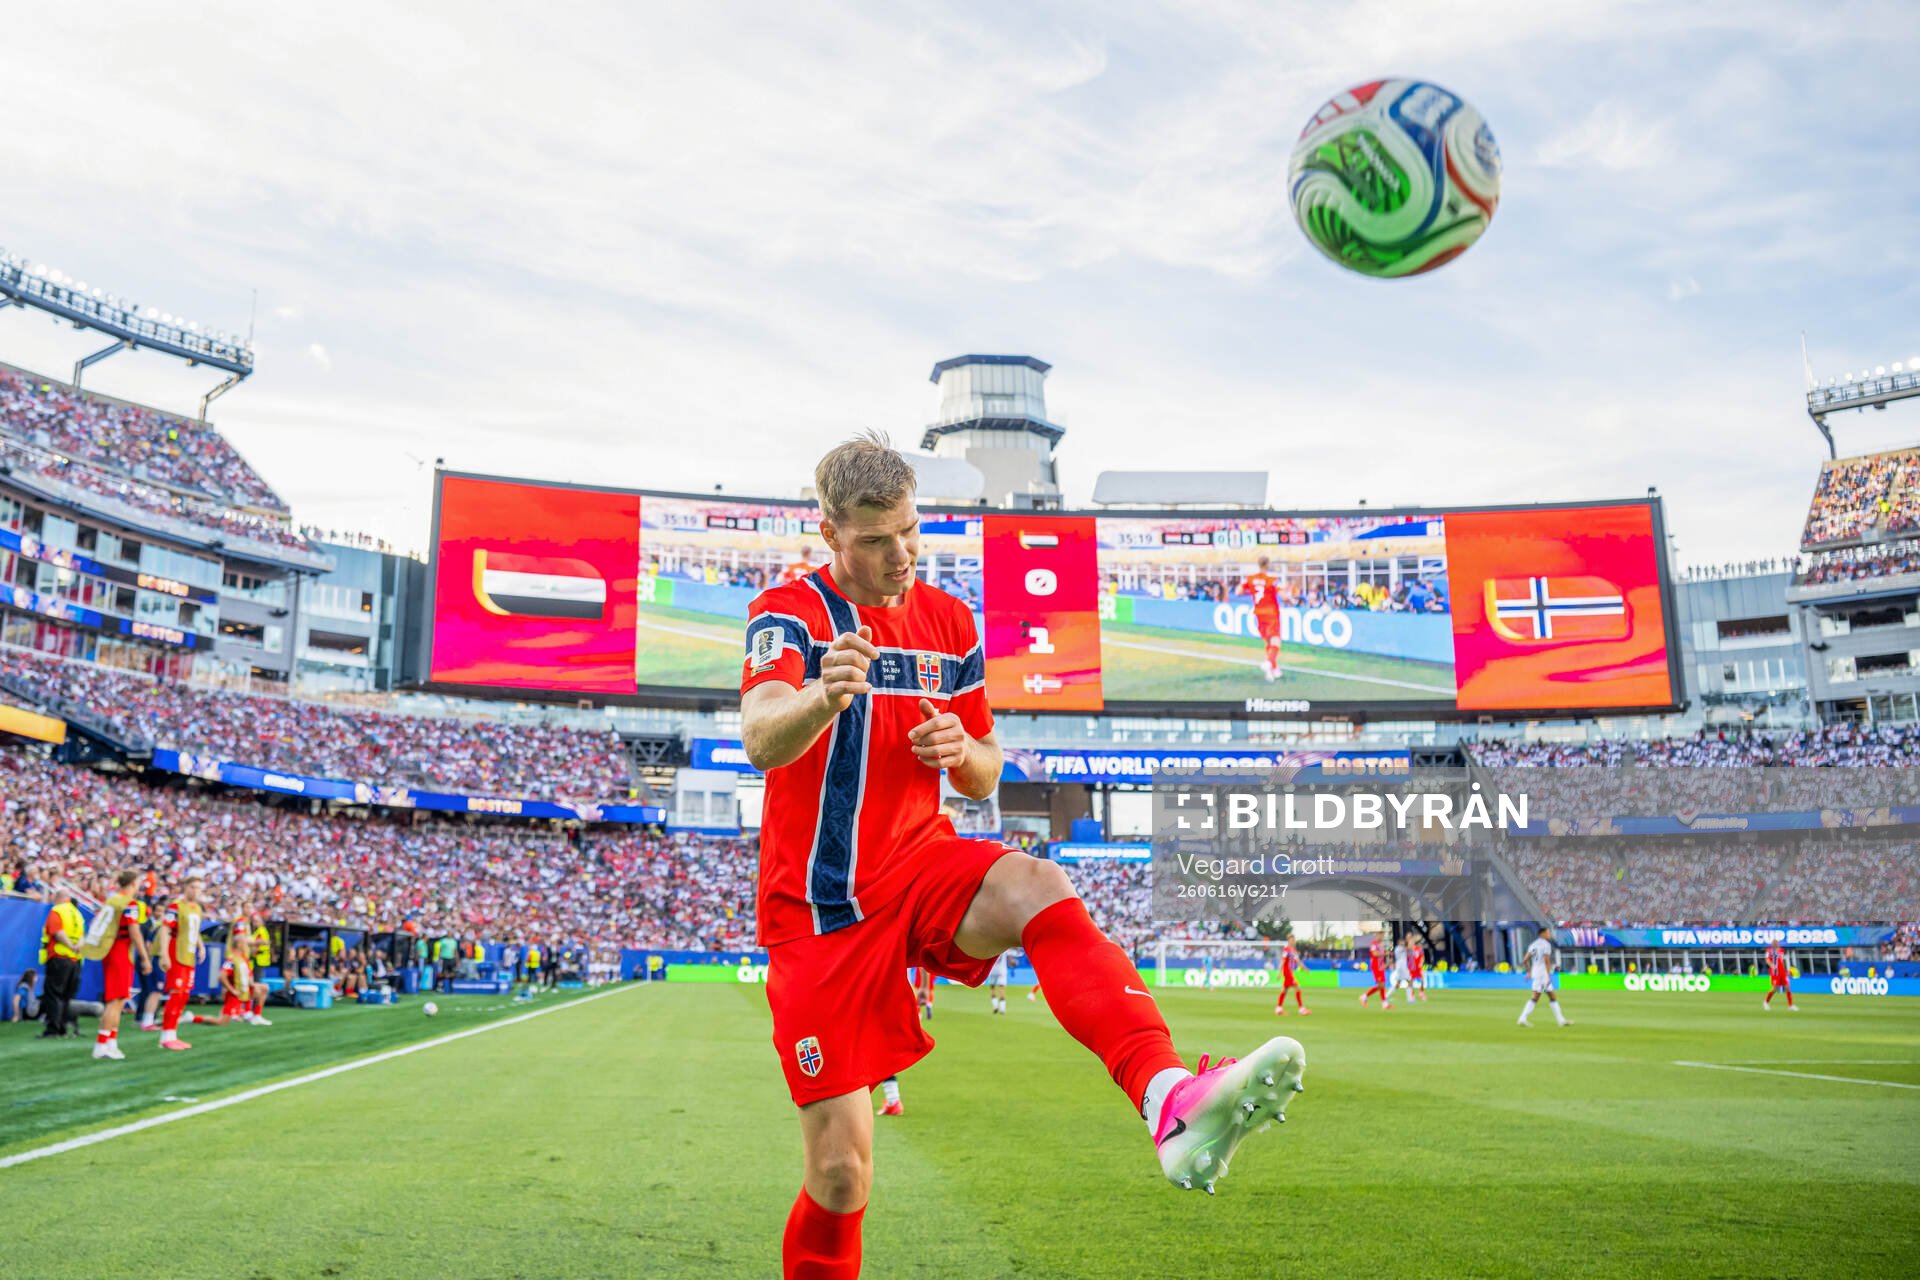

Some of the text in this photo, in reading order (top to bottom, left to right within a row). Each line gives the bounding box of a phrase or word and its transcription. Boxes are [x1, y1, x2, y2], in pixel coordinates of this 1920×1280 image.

[1118, 532, 1153, 545] 35:19
[1025, 569, 1057, 596] 0
[1029, 627, 1055, 654] 1
[1245, 698, 1311, 713] Hisense
[1044, 756, 1272, 776] FIFA WORLD CUP 2026
[1322, 757, 1409, 776] BOSTON
[1663, 929, 1838, 944] FIFA WORLD CUP 2026
[1184, 968, 1270, 987] aamco
[1624, 974, 1710, 992] aramco
[1831, 977, 1888, 995] aramco
